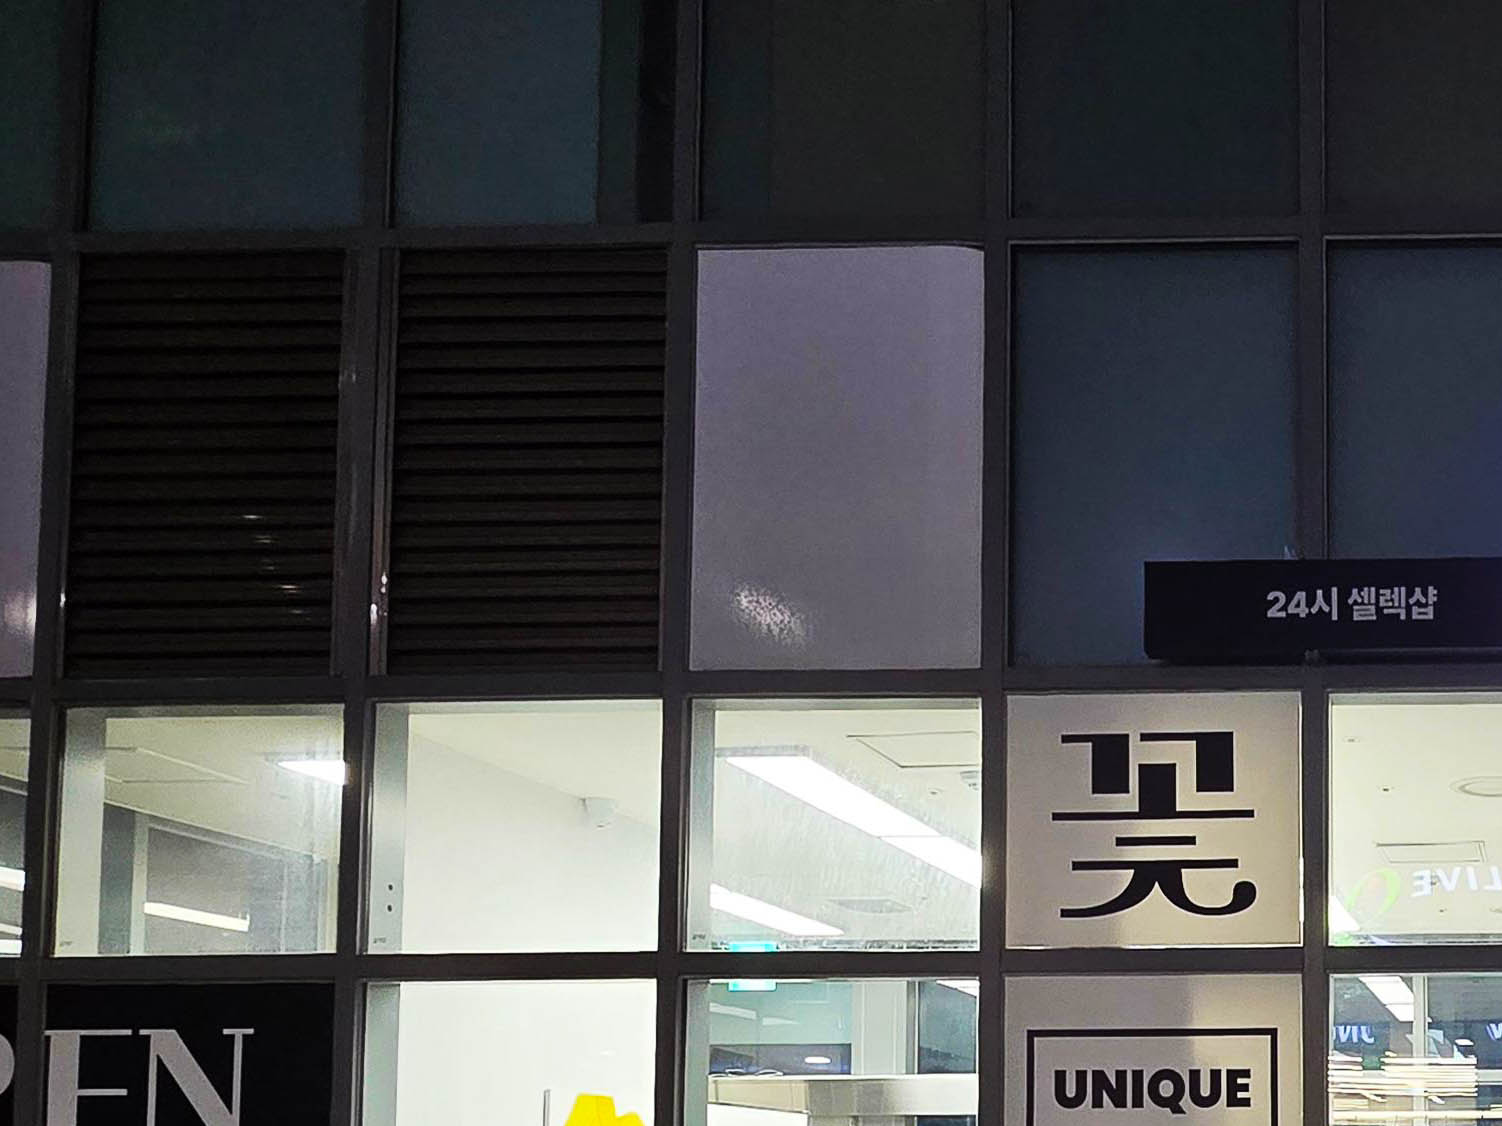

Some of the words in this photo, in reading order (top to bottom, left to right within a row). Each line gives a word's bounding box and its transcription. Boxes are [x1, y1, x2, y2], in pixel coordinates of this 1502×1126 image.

[1265, 585, 1339, 622] 24시
[1346, 585, 1439, 622] 셀렉샵
[1051, 731, 1257, 918] 꽃
[1054, 1068, 1251, 1115] UNIQUE
